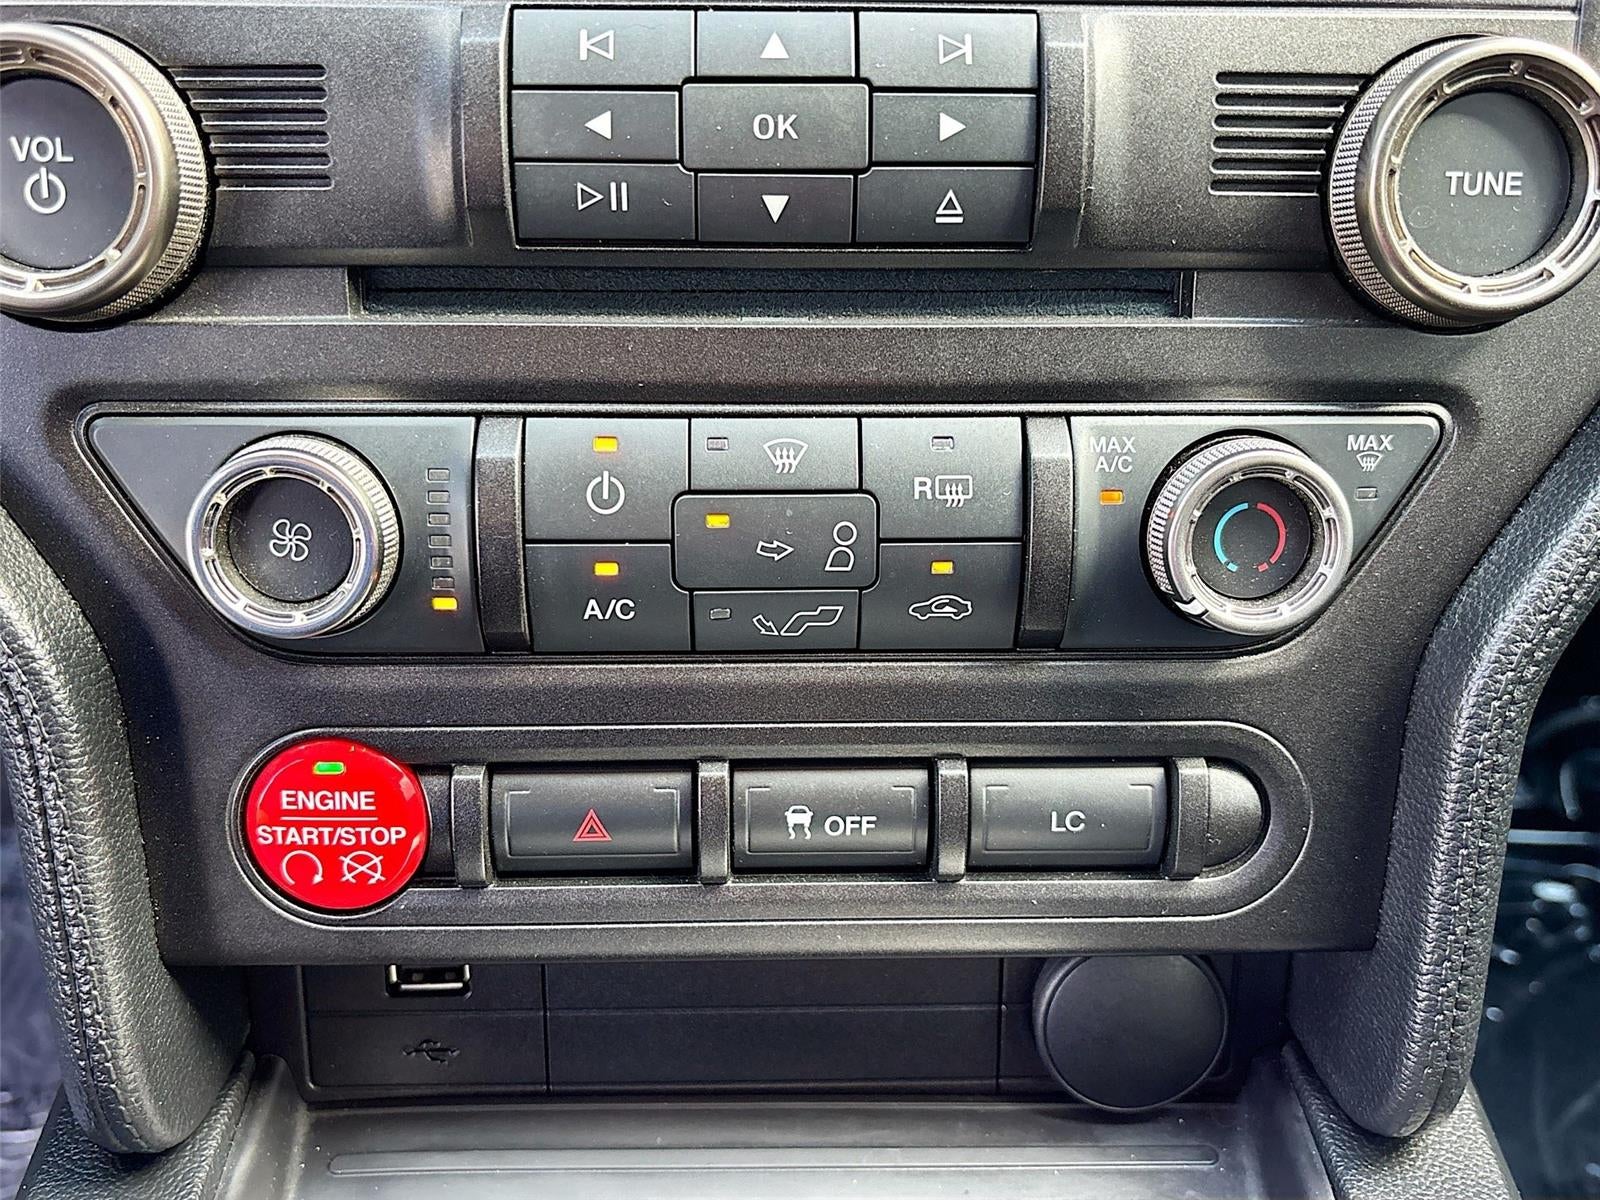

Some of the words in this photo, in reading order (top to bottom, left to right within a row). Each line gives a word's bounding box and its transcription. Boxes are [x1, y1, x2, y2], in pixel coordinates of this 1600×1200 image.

[752, 114, 800, 140] OK
[9, 136, 74, 164] VOL
[1445, 170, 1524, 198] TUNE
[1089, 435, 1136, 453] MAX
[1346, 435, 1393, 452] MAX
[1094, 453, 1134, 473] A/C
[913, 477, 932, 499] R
[583, 599, 636, 621] A/C
[280, 789, 376, 812] ENGINE
[824, 815, 877, 837] OFF
[1050, 810, 1086, 832] LC
[257, 825, 407, 848] START/STOP
